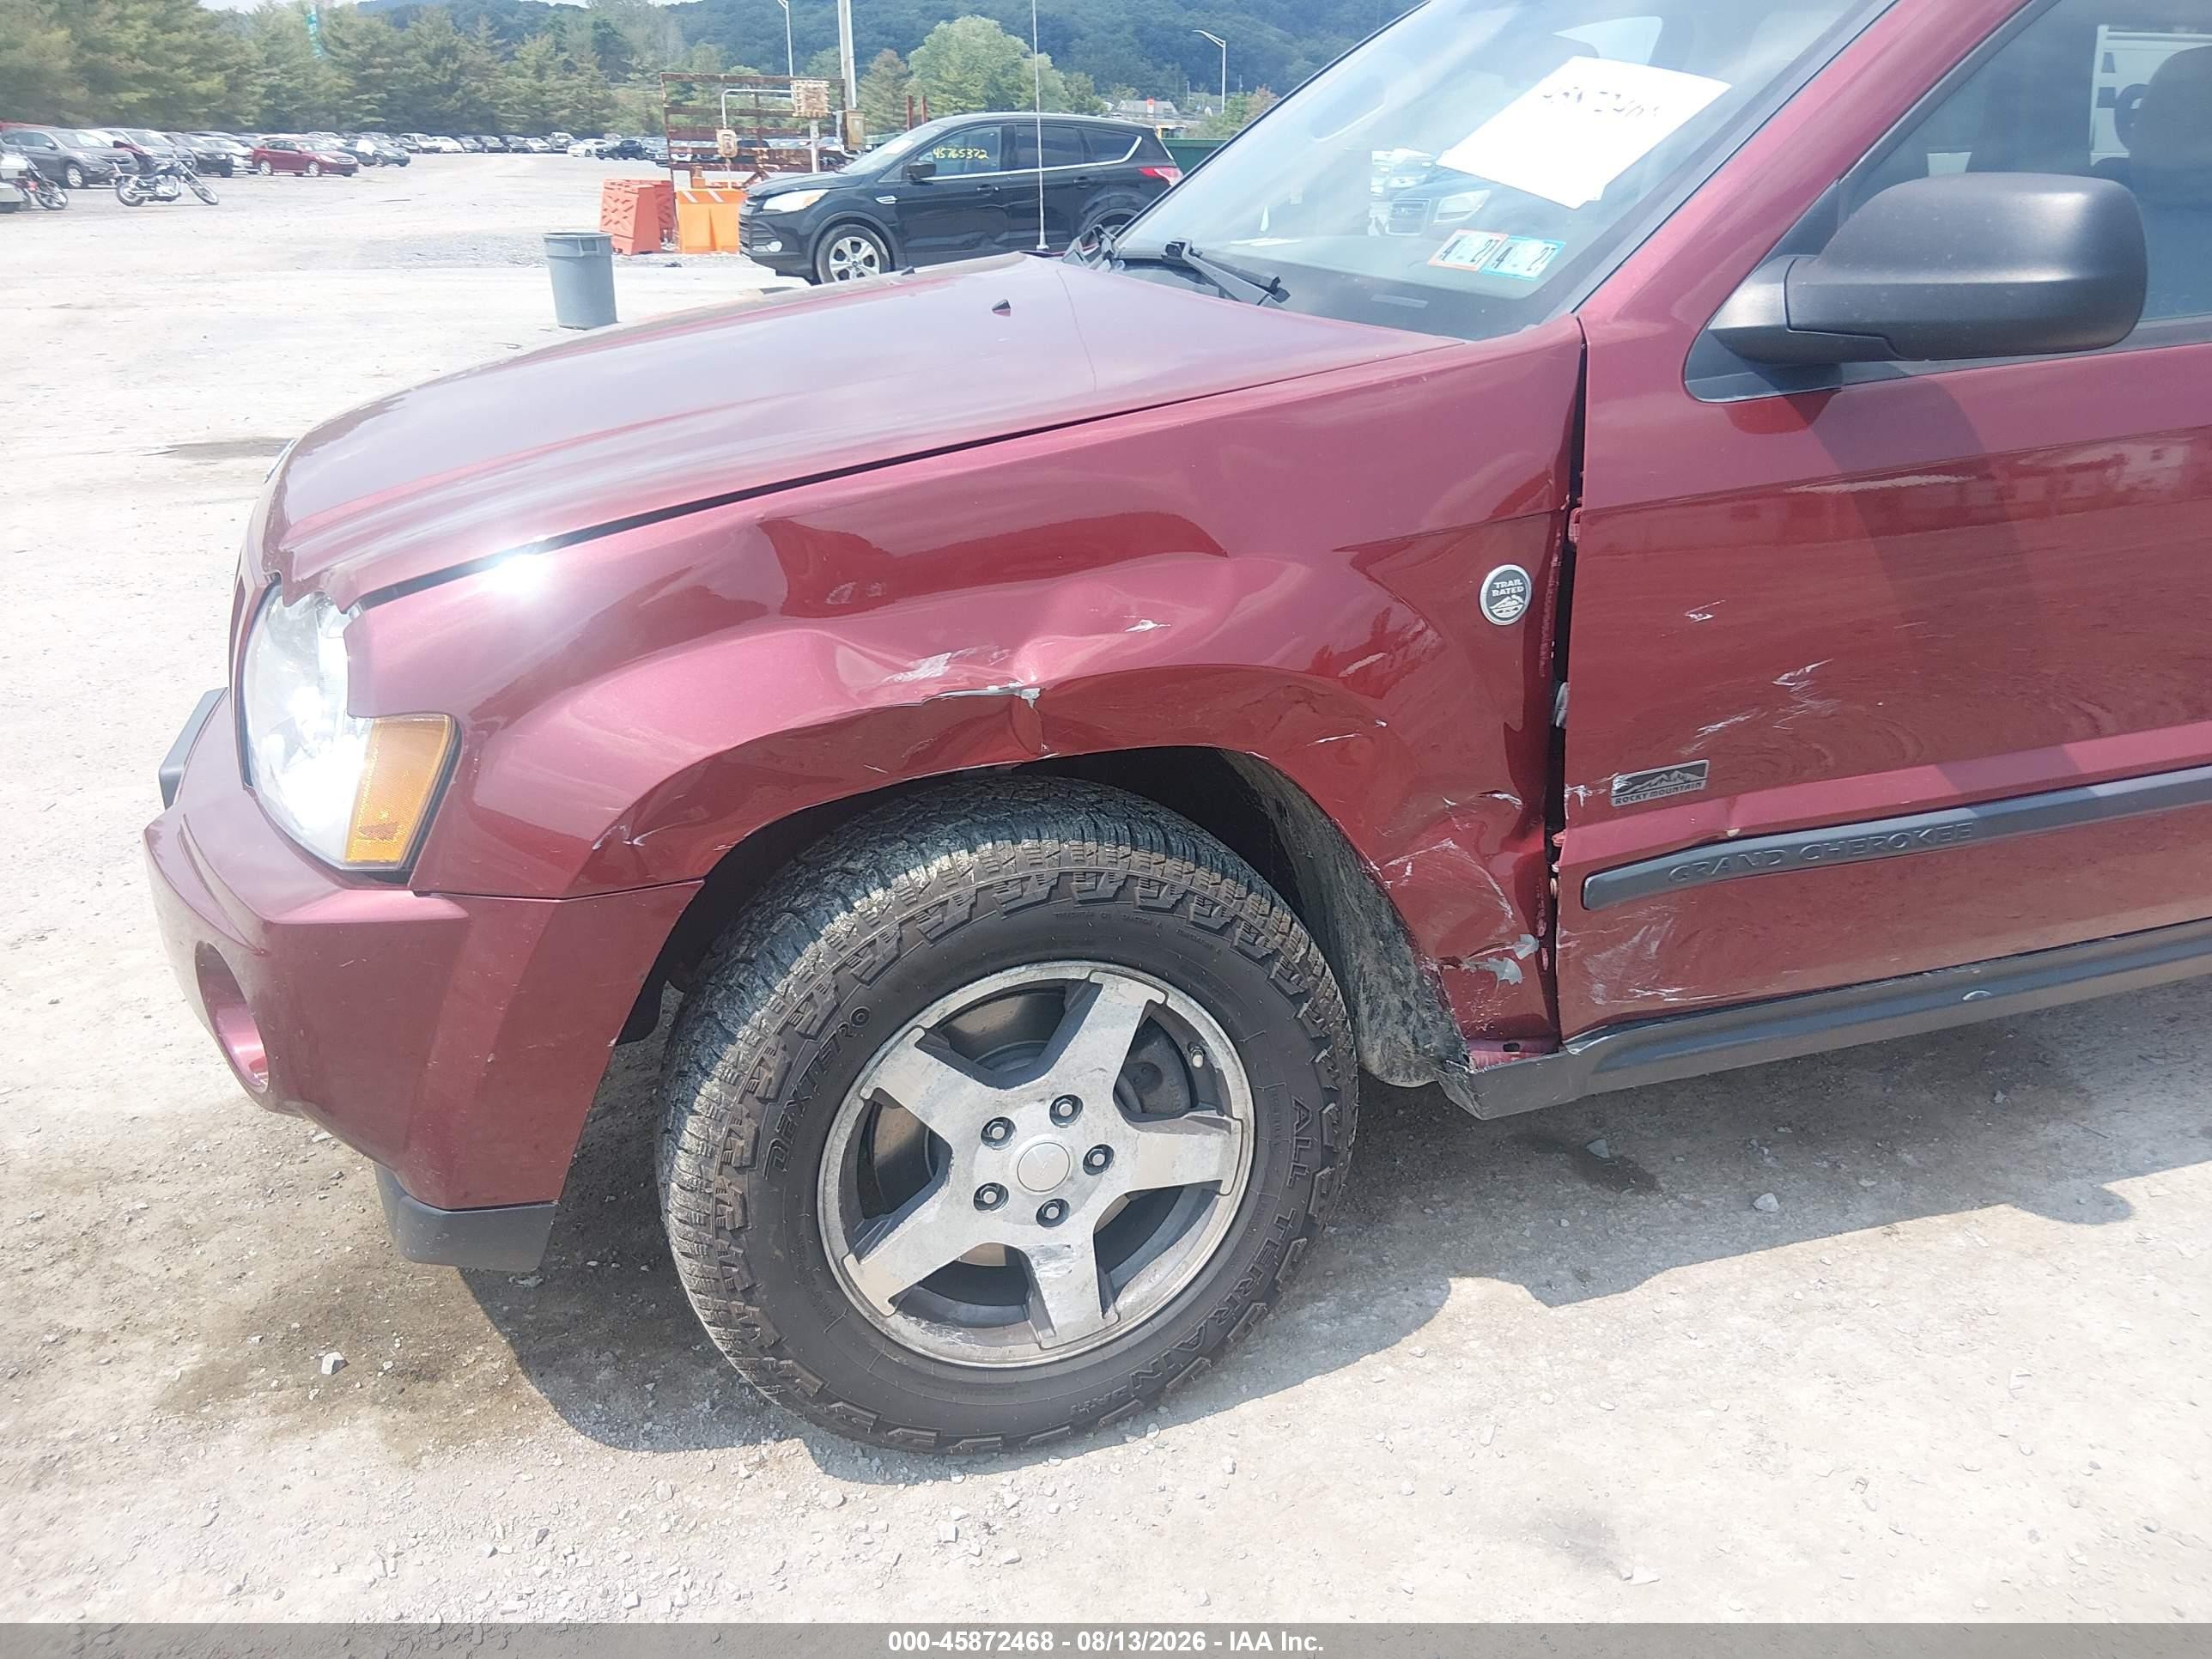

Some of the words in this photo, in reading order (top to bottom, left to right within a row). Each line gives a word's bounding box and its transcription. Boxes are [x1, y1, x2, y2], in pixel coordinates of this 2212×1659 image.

[1491, 586, 1525, 597] RATED
[1492, 578, 1523, 589] TRAIL
[1614, 793, 1649, 805] ROCKY
[1649, 781, 1703, 798] MOUNTAIN
[1668, 848, 1787, 883] GRAND
[1798, 821, 1974, 861] CHEROKEE
[1285, 1094, 1313, 1188] ALL
[1129, 1207, 1297, 1400] TERRAIN
